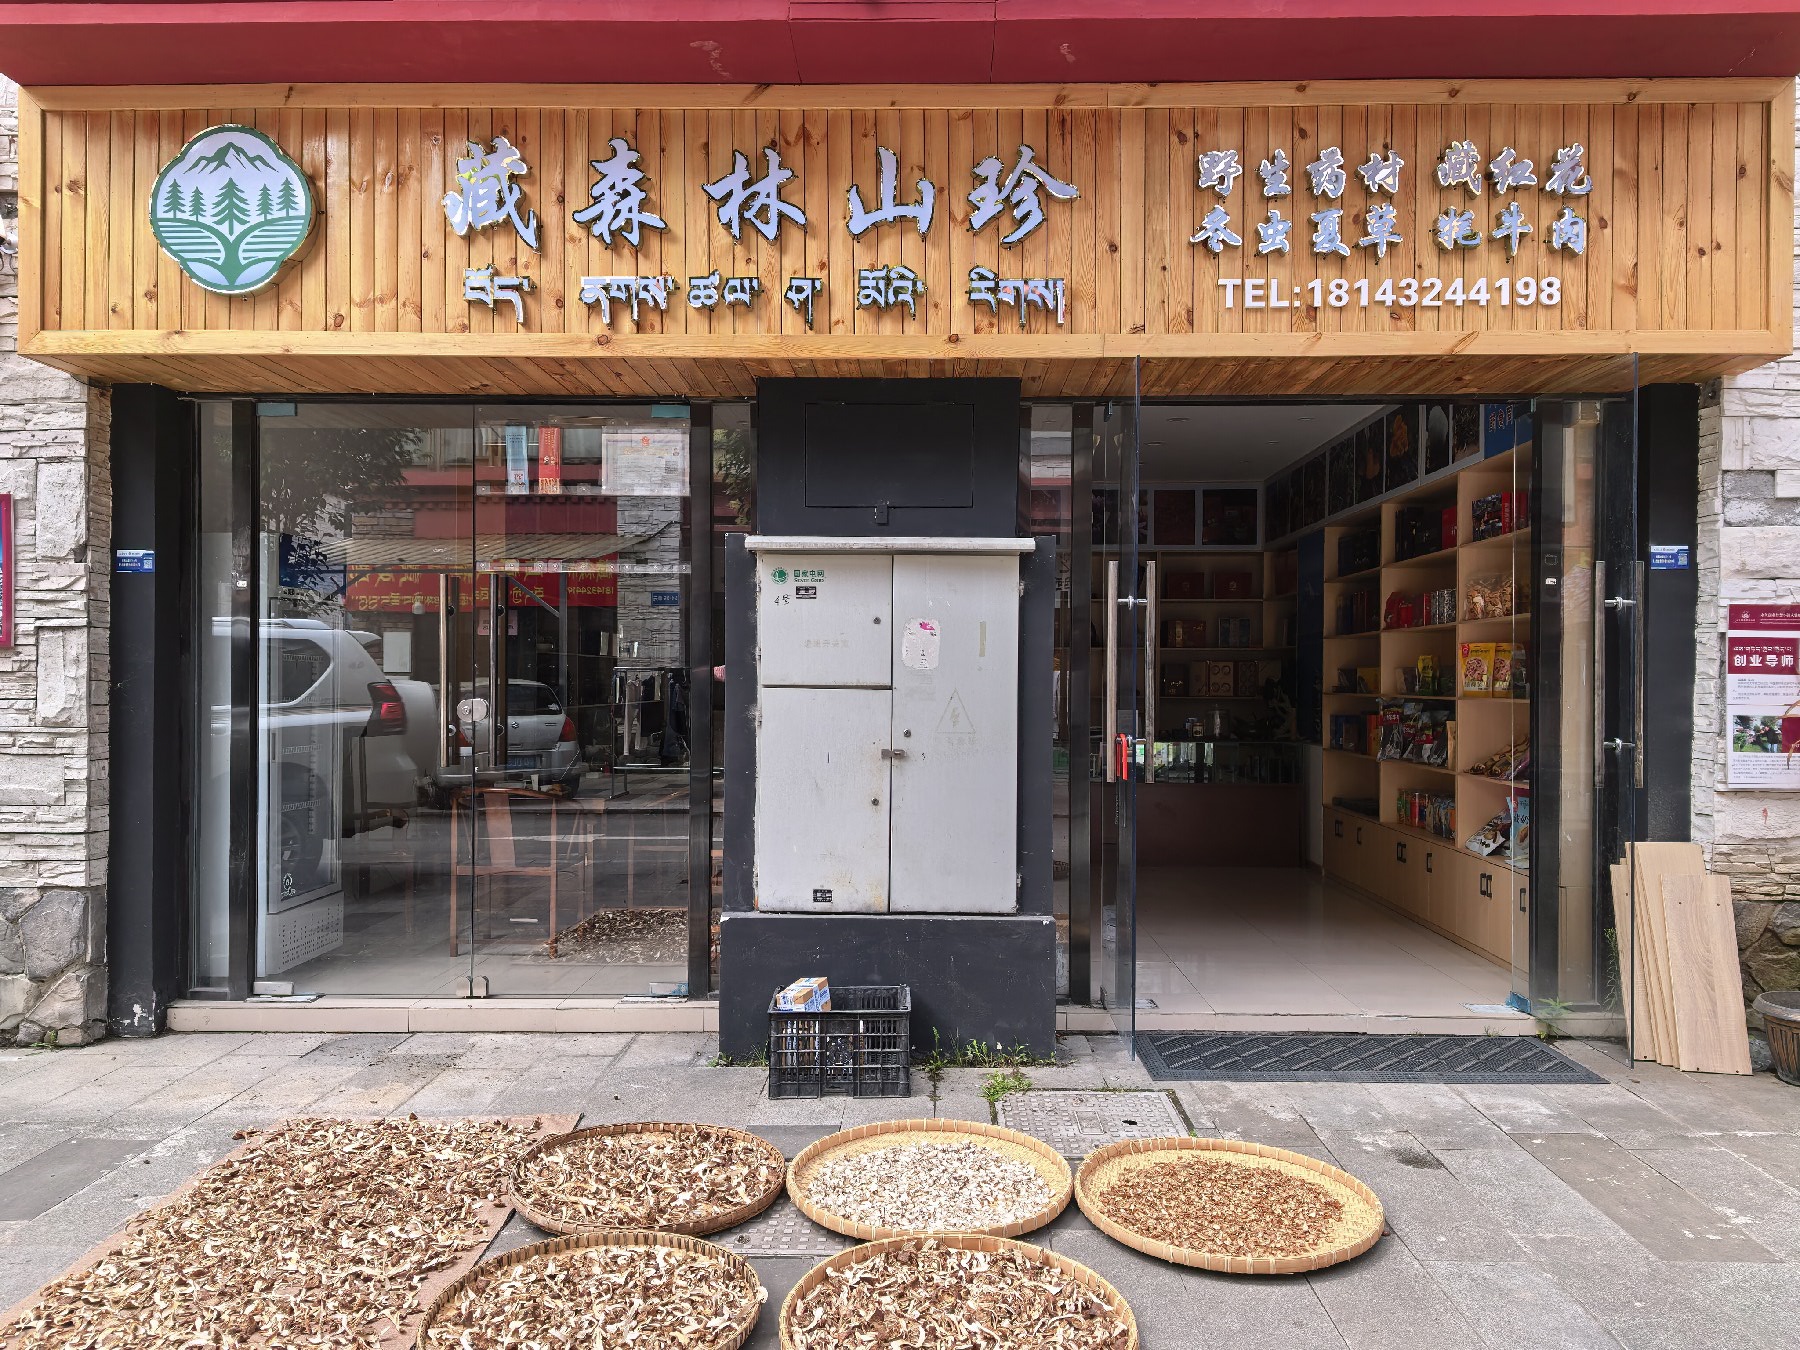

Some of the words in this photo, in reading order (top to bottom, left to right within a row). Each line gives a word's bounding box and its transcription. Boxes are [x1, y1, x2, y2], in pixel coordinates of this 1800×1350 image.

[1197, 146, 1404, 198] 野生药材
[1436, 140, 1593, 196] 藏红花
[443, 135, 1080, 253] 藏森林山珍
[1190, 203, 1404, 259] 冬虫夏草
[1436, 201, 1588, 258] 牦牛肉
[1217, 276, 1562, 308] TEL:18143244198
[793, 569, 825, 578] 国家电网
[1733, 654, 1794, 667] 创业导师
